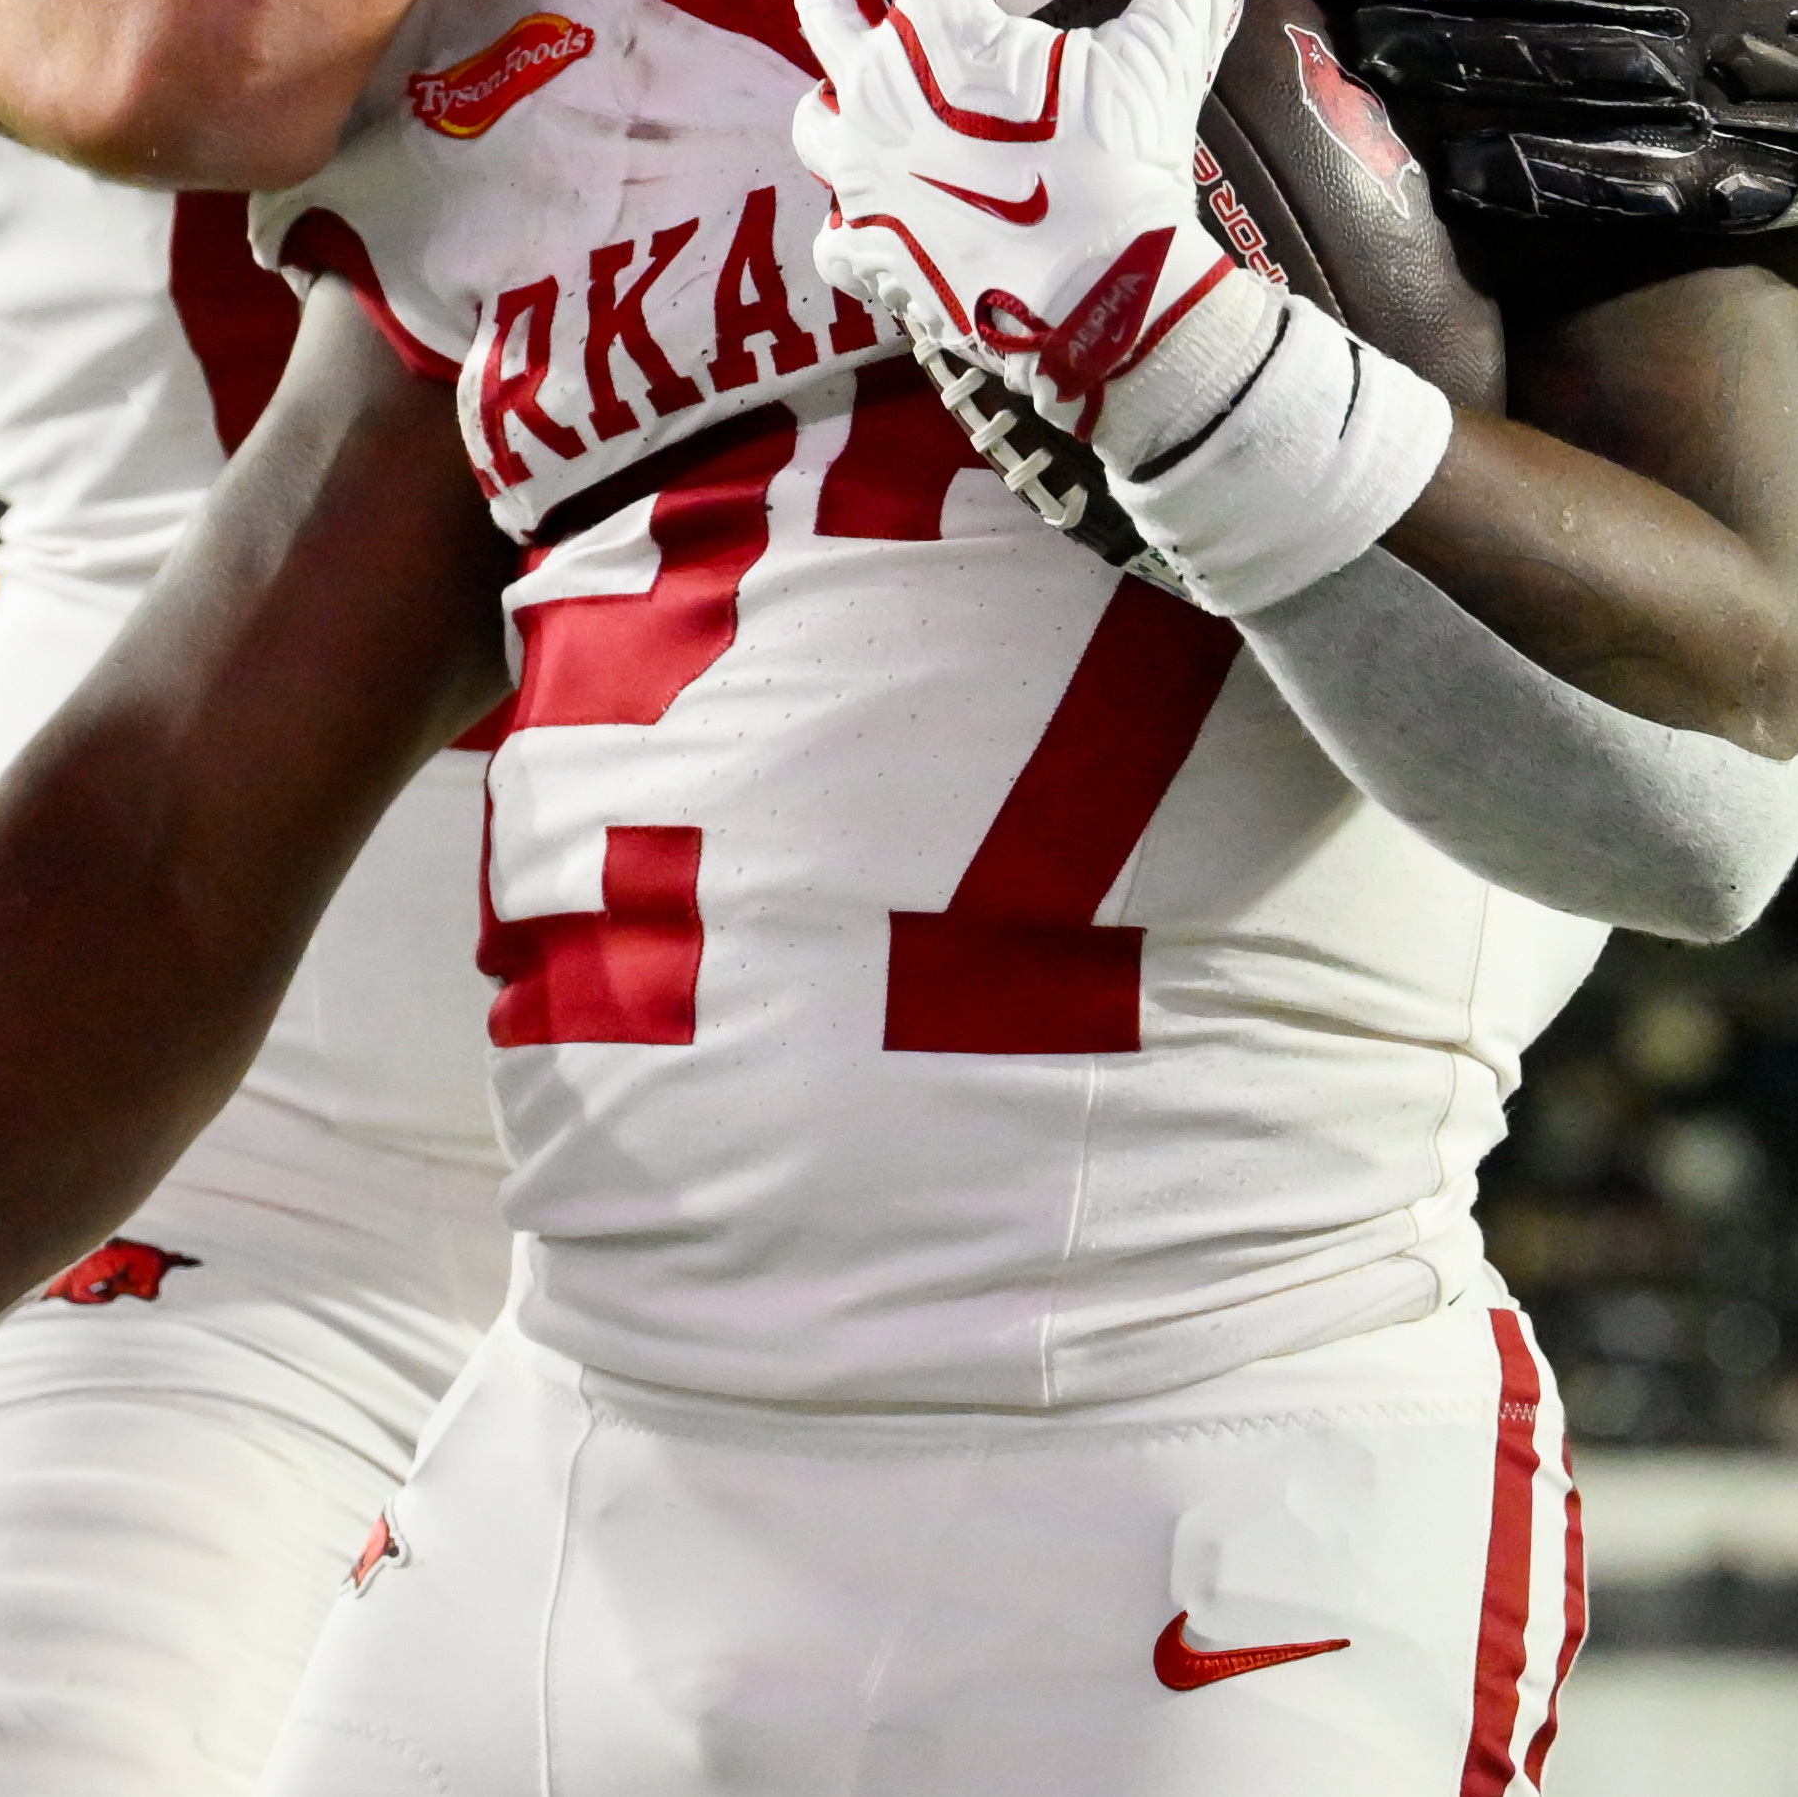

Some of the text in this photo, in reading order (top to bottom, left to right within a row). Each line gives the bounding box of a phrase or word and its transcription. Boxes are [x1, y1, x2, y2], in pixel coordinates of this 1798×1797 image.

[1068, 272, 1148, 369] ALPHA
[1209, 179, 1290, 284] POR
[467, 186, 879, 500] RKA
[476, 354, 1245, 1055] 27
